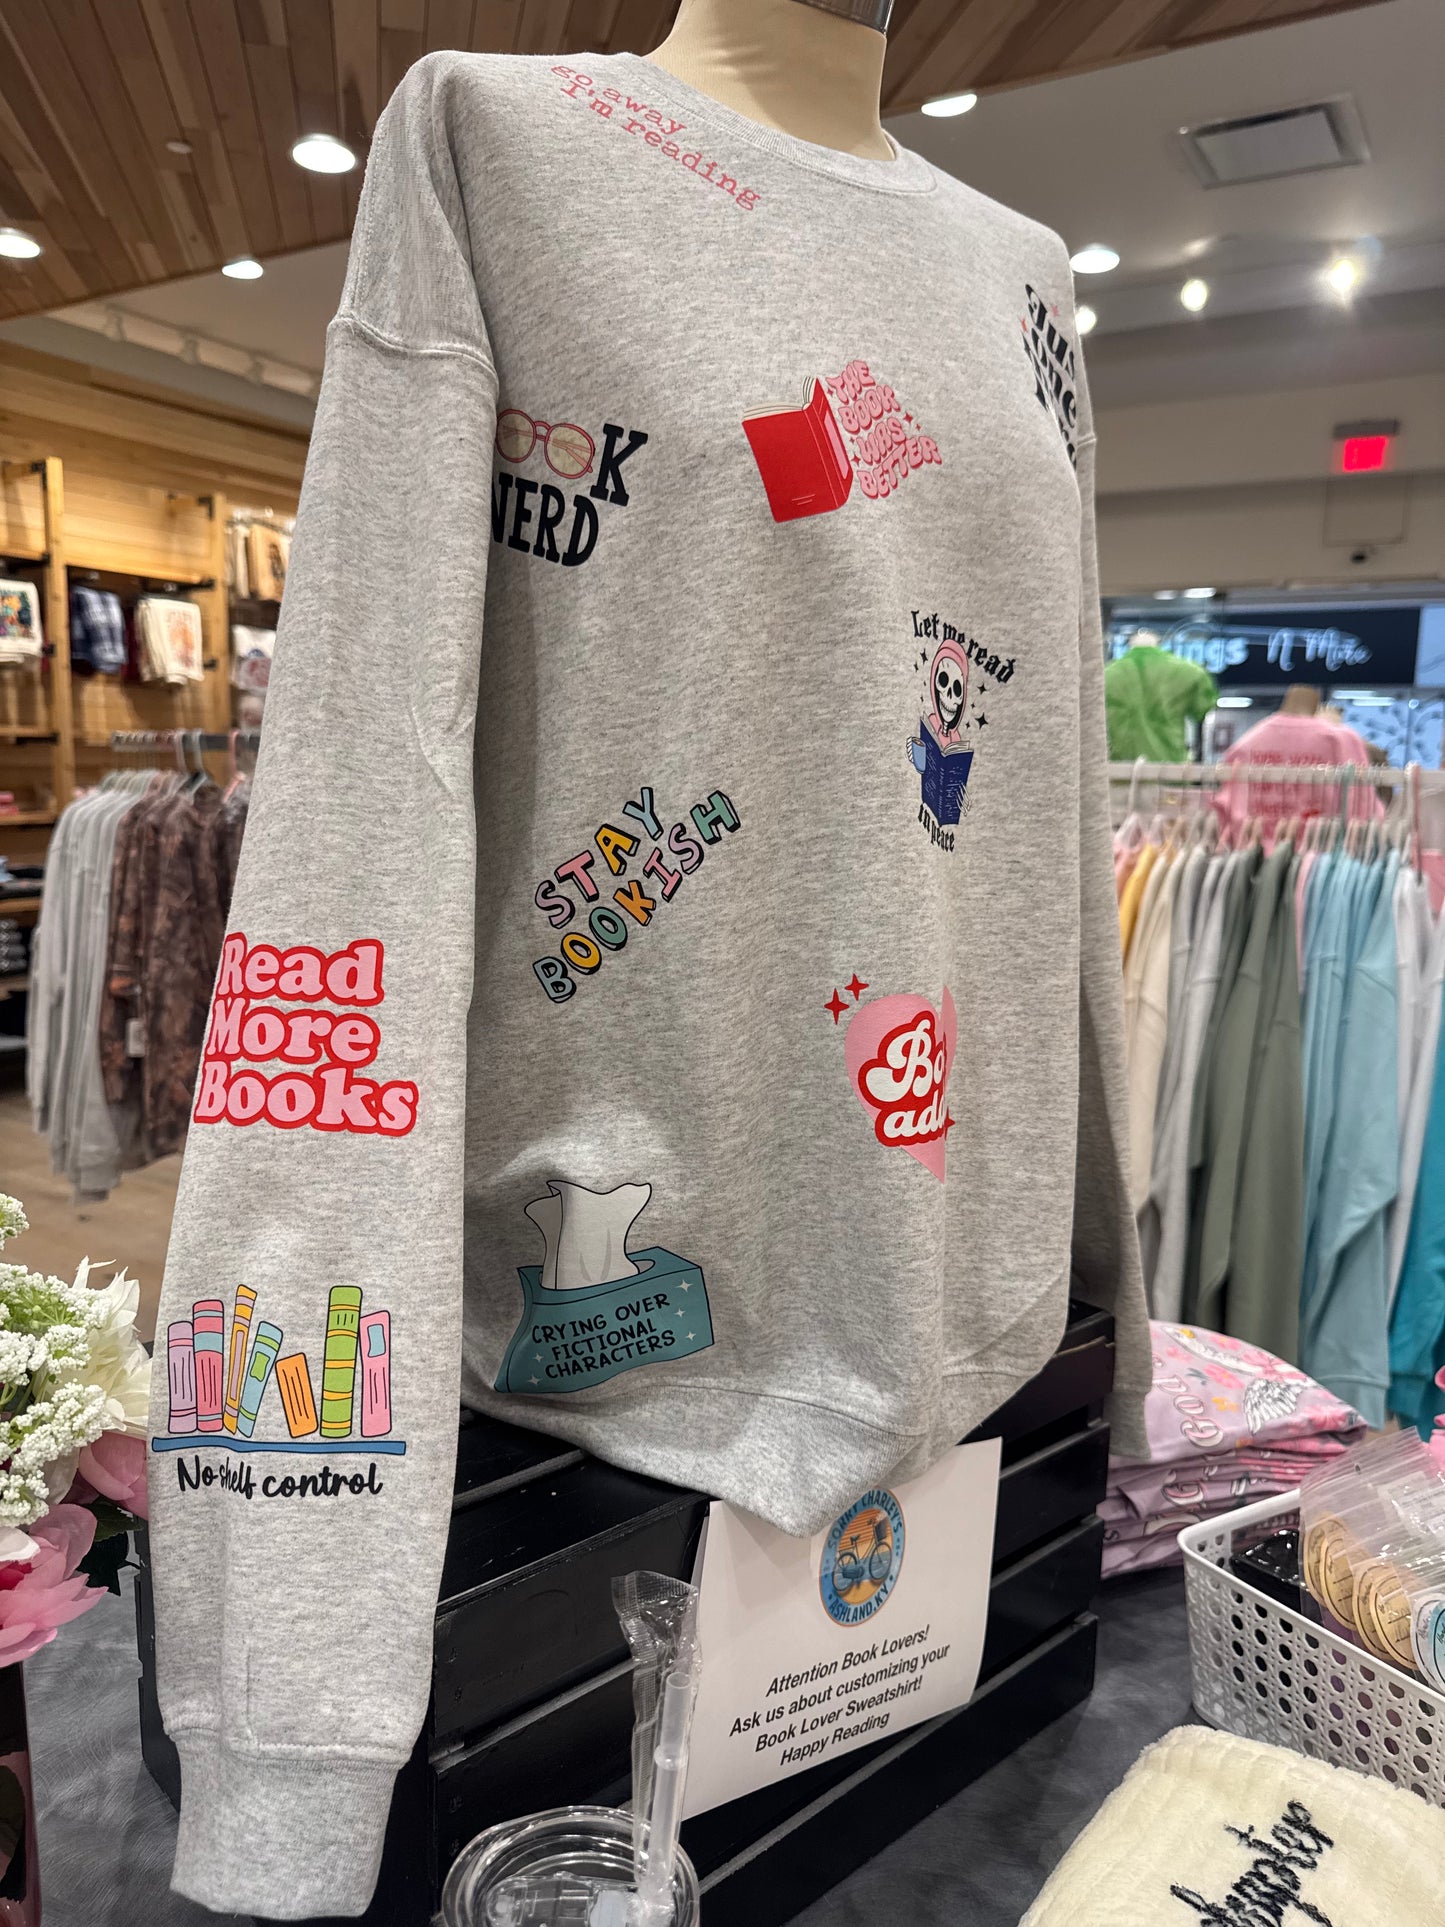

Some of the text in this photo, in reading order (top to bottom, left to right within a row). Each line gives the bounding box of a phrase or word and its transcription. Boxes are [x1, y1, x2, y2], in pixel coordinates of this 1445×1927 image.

[551, 65, 687, 135] go away
[560, 80, 762, 211] I'm reading
[825, 360, 876, 405] THE
[838, 385, 901, 435] BOOK
[856, 417, 907, 466] WAS
[857, 435, 942, 500] BETTER
[911, 610, 1016, 684] Let me read
[535, 786, 664, 929] STAY
[930, 820, 955, 853] peace
[533, 790, 741, 1003] BOOKISH
[216, 933, 383, 1005] Read
[205, 997, 379, 1065] More
[195, 1058, 417, 1134] Books
[532, 1293, 670, 1343] CRYING OVER
[551, 1318, 657, 1361] FICTIONAL
[545, 1329, 675, 1379] CHARACTERS
[177, 1455, 384, 1499] No shelf control
[861, 1489, 903, 1534] CHARLEY'S
[729, 1644, 950, 1737] Ask us about customizing your
[765, 1624, 930, 1698] Attention Book Lovers!
[755, 1675, 923, 1752] Book Lover Sweatshirt!
[780, 1712, 890, 1766] Happy Reading
